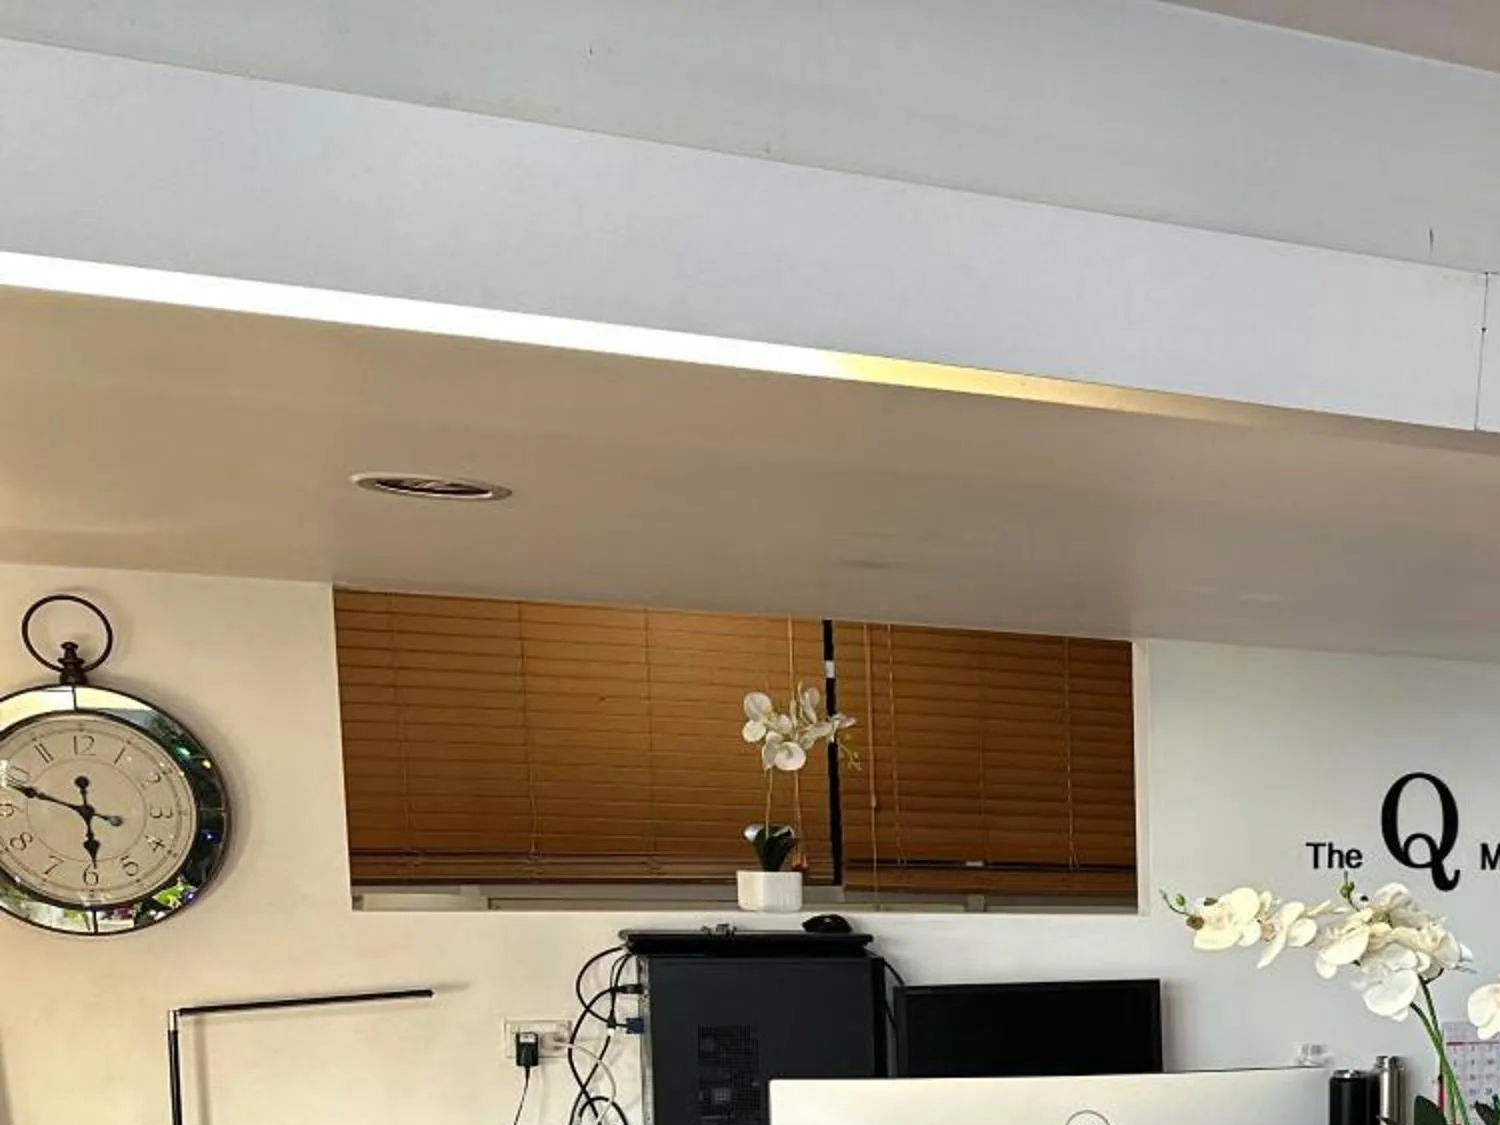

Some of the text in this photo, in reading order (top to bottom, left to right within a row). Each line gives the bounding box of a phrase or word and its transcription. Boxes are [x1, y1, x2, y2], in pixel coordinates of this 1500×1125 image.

[33, 742, 55, 765] 11
[72, 734, 97, 757] 12
[113, 747, 127, 766] 1
[140, 772, 162, 791] 2
[149, 806, 174, 820] 3
[9, 831, 34, 852] 8
[1305, 841, 1364, 870] The
[1380, 771, 1461, 893] Q
[145, 834, 166, 853] 4
[43, 855, 65, 877] 7
[83, 862, 100, 887] 6
[120, 855, 140, 878] 5
